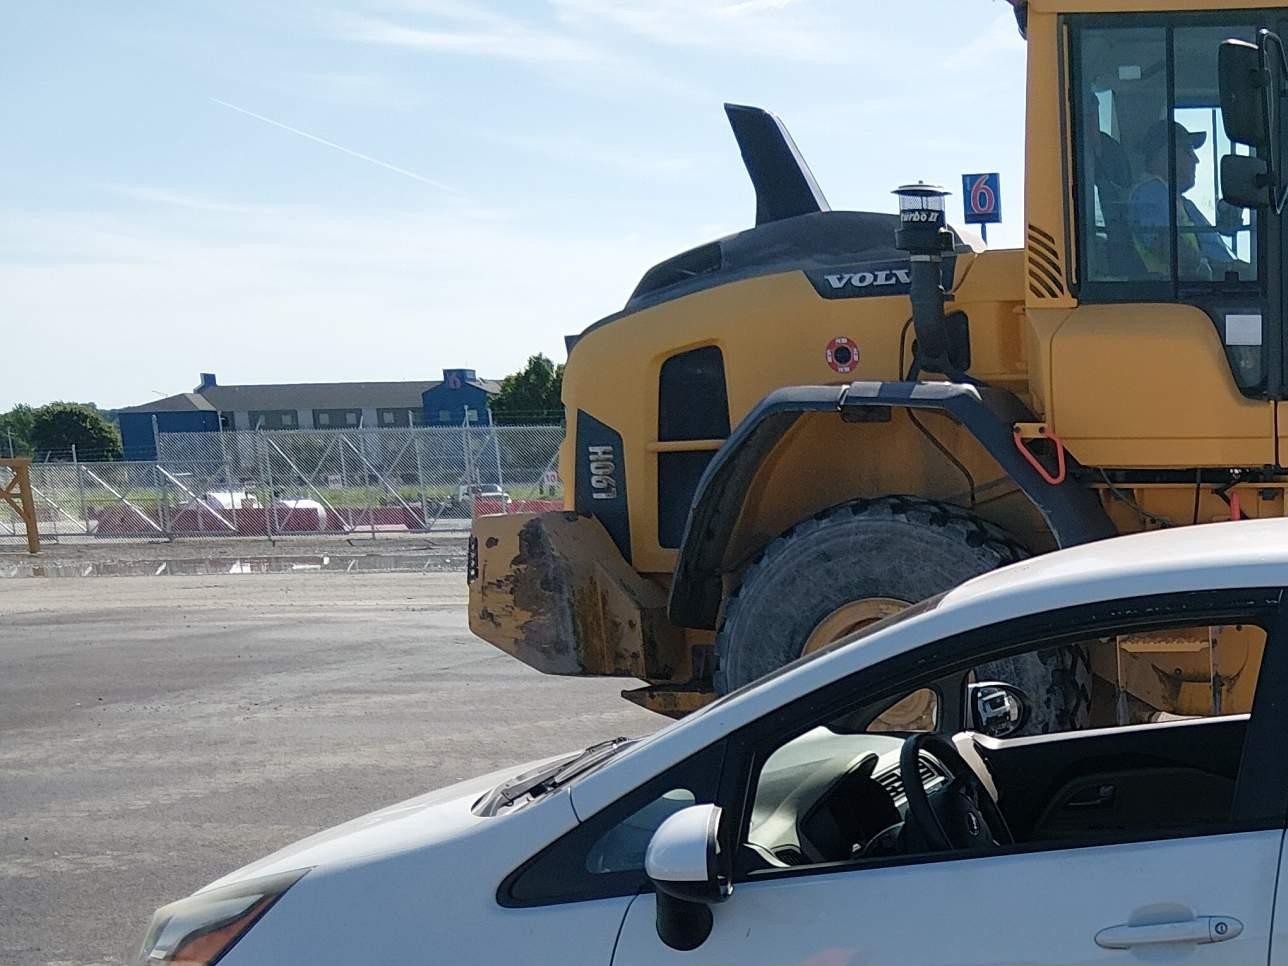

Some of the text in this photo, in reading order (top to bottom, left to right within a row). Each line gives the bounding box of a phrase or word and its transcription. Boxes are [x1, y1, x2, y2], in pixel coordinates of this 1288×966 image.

[970, 174, 995, 214] 6
[823, 269, 911, 289] VOLV
[588, 446, 616, 499] L90H
